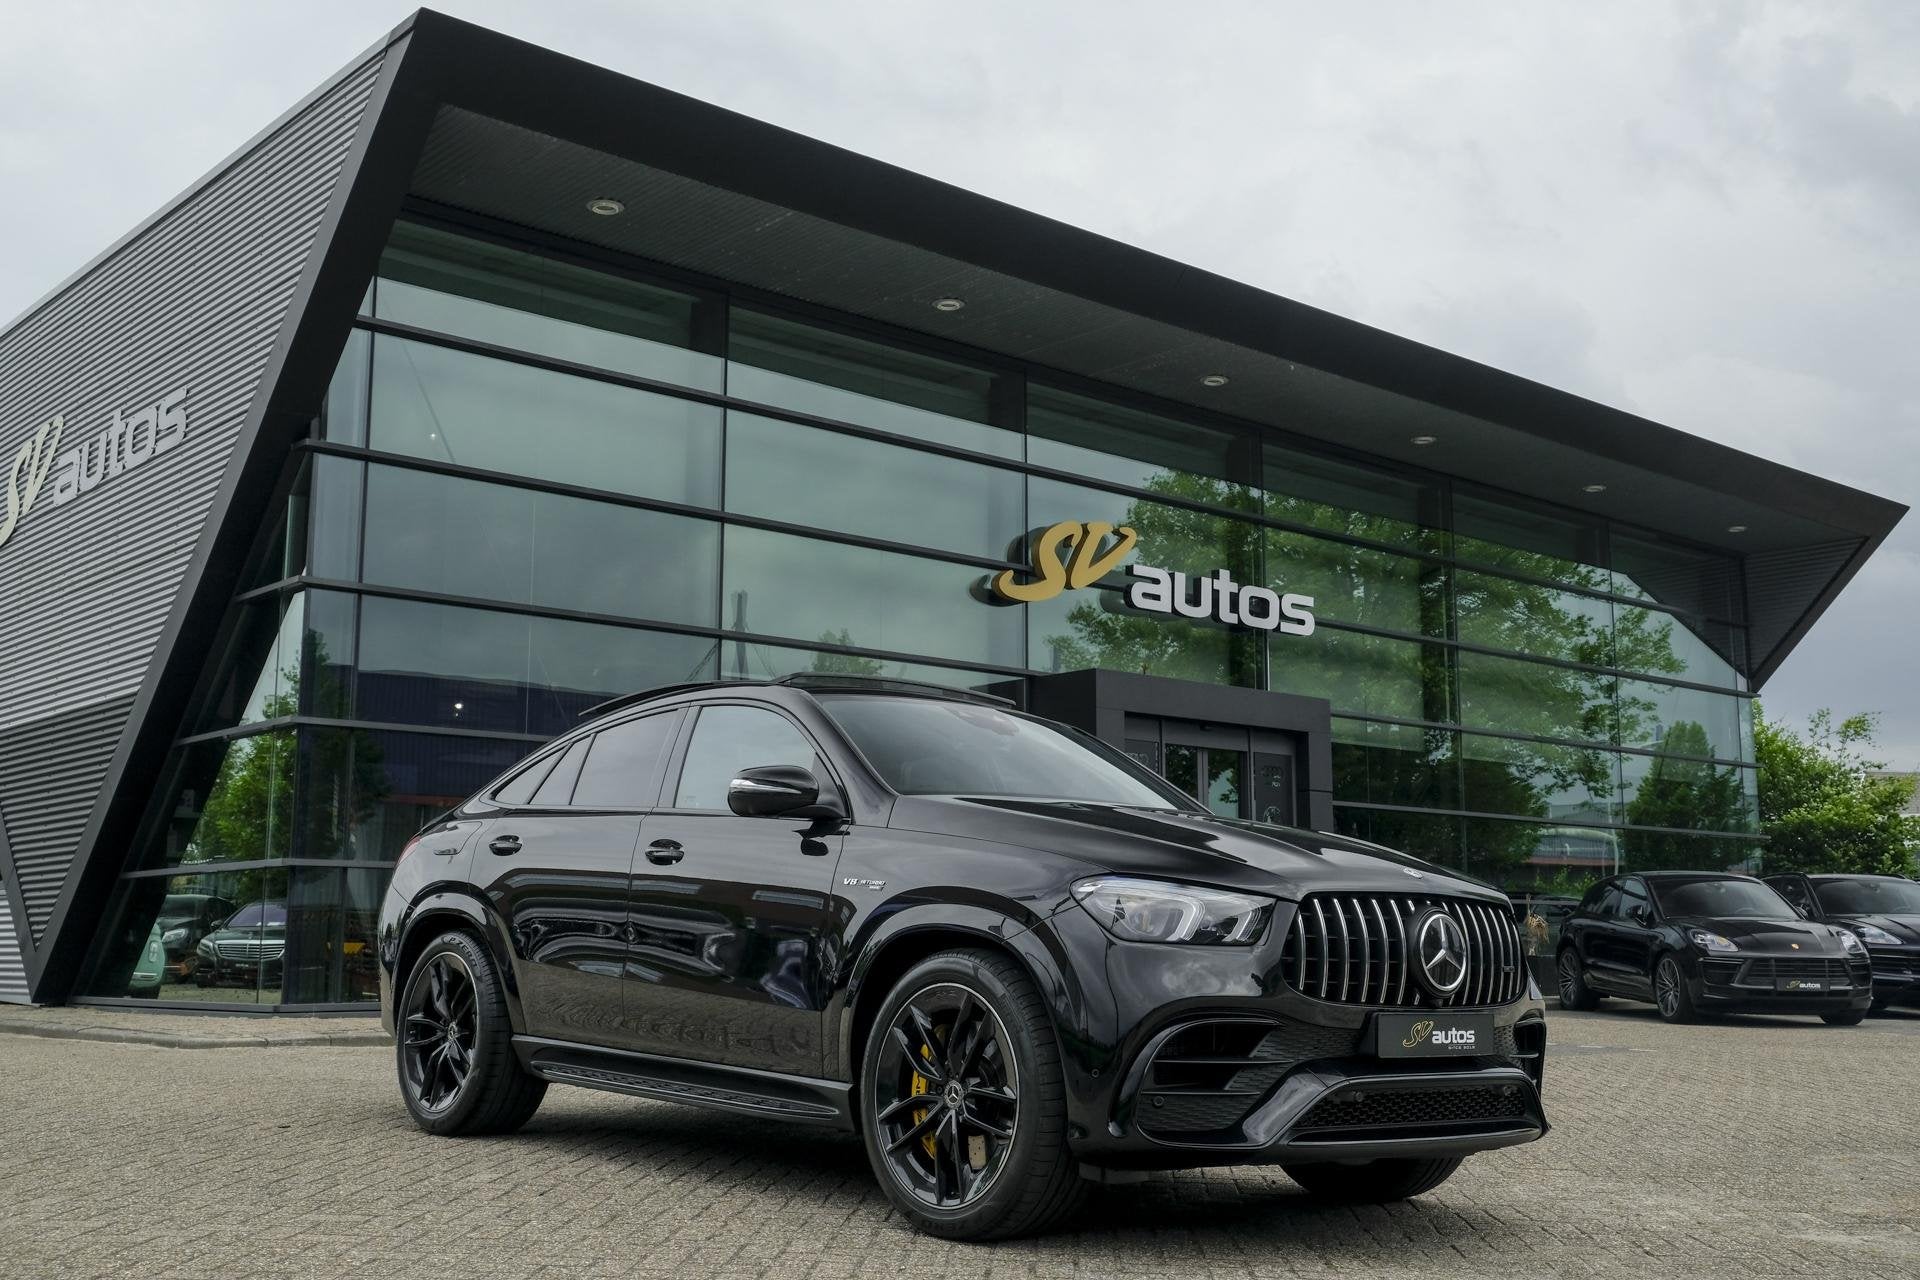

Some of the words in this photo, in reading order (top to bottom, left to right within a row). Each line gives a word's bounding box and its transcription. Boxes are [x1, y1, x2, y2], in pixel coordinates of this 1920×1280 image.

[53, 384, 188, 507] autos
[998, 520, 1138, 602] SV
[1128, 564, 1316, 636] autos
[1402, 1020, 1434, 1048] SV
[1431, 1027, 1475, 1044] autos
